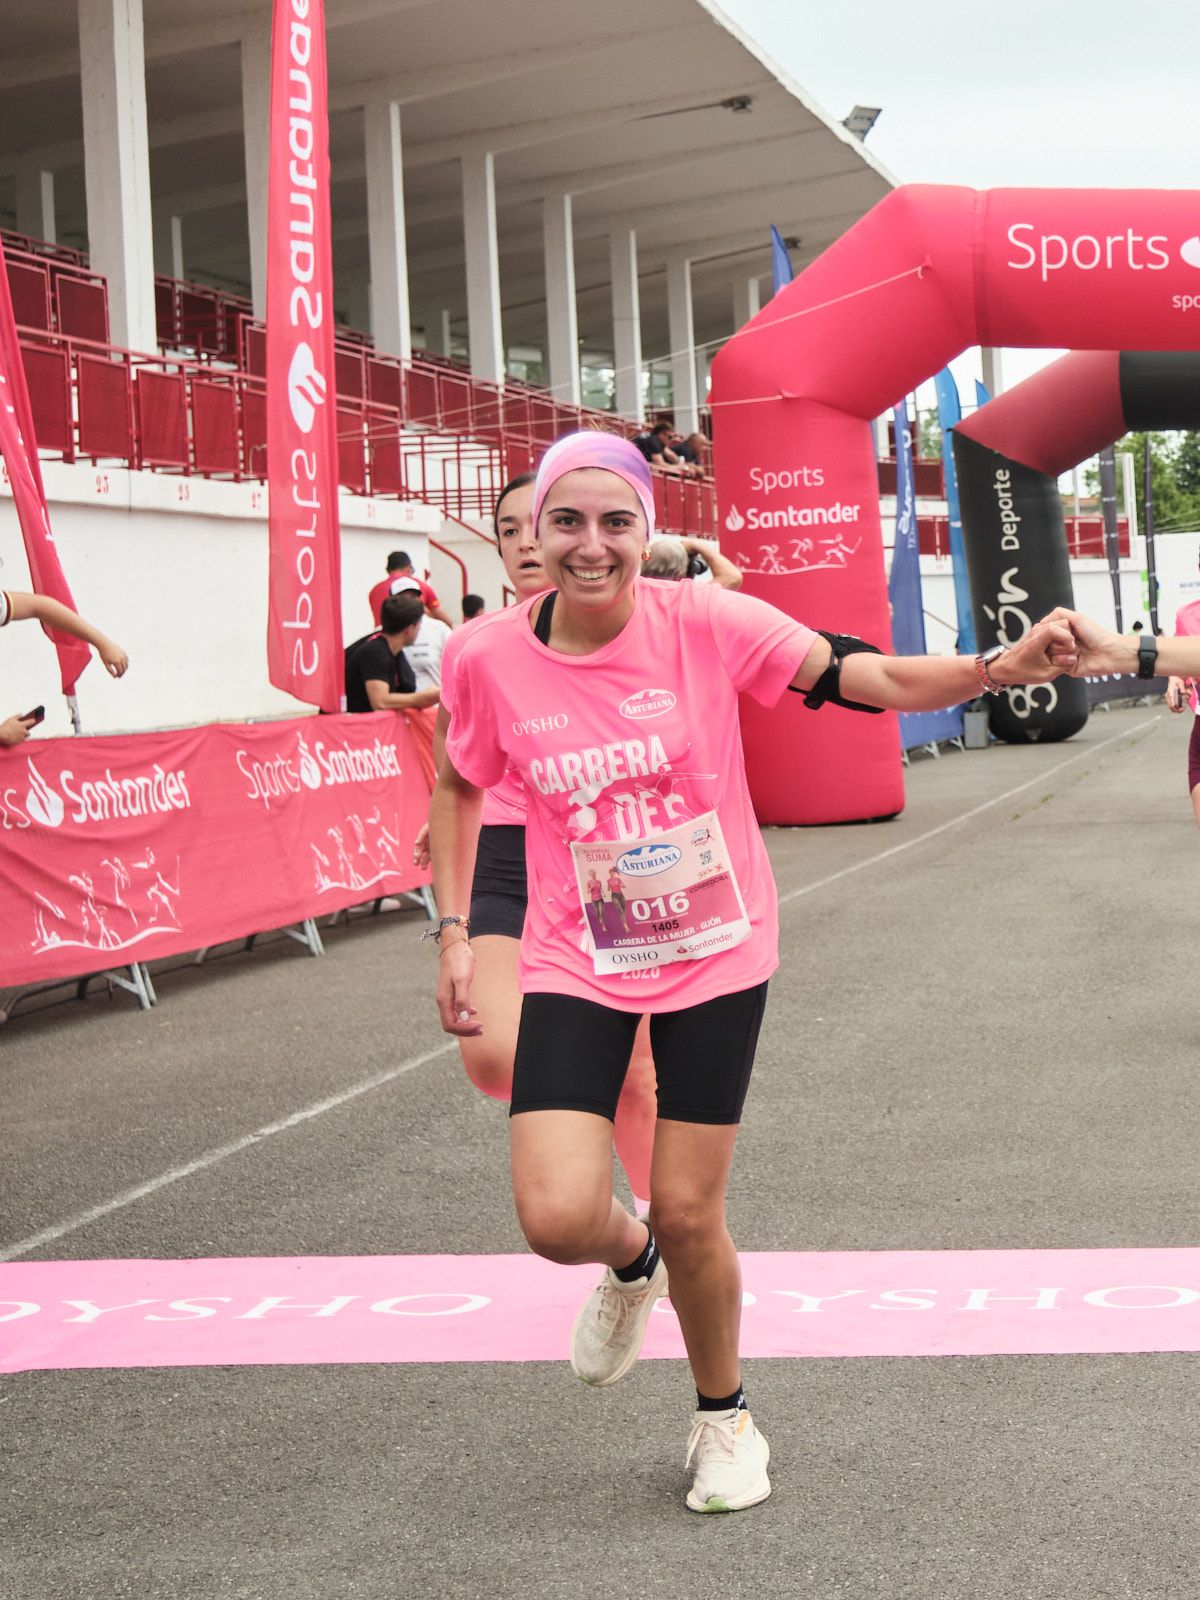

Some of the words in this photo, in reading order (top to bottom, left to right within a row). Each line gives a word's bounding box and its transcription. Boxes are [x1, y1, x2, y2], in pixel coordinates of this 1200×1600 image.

[1007, 223, 1169, 281] Sports
[750, 466, 825, 495] Sports
[747, 502, 860, 530] Santander
[993, 468, 1022, 551] Deporte
[512, 713, 569, 737] OYSHO
[236, 750, 301, 811] Sports
[314, 738, 401, 787] Santander
[529, 735, 673, 796] CARRERA
[60, 763, 191, 825] Santander
[586, 853, 613, 862] SUMA
[622, 852, 678, 871] ASTURIANA
[631, 891, 690, 921] 016
[613, 935, 647, 947] CARRERA
[647, 936, 657, 944] DE
[658, 934, 669, 942] LA
[669, 927, 695, 941] MUJER
[651, 919, 680, 932] 1405
[612, 950, 658, 965] OYSHO
[688, 932, 734, 953] Santander
